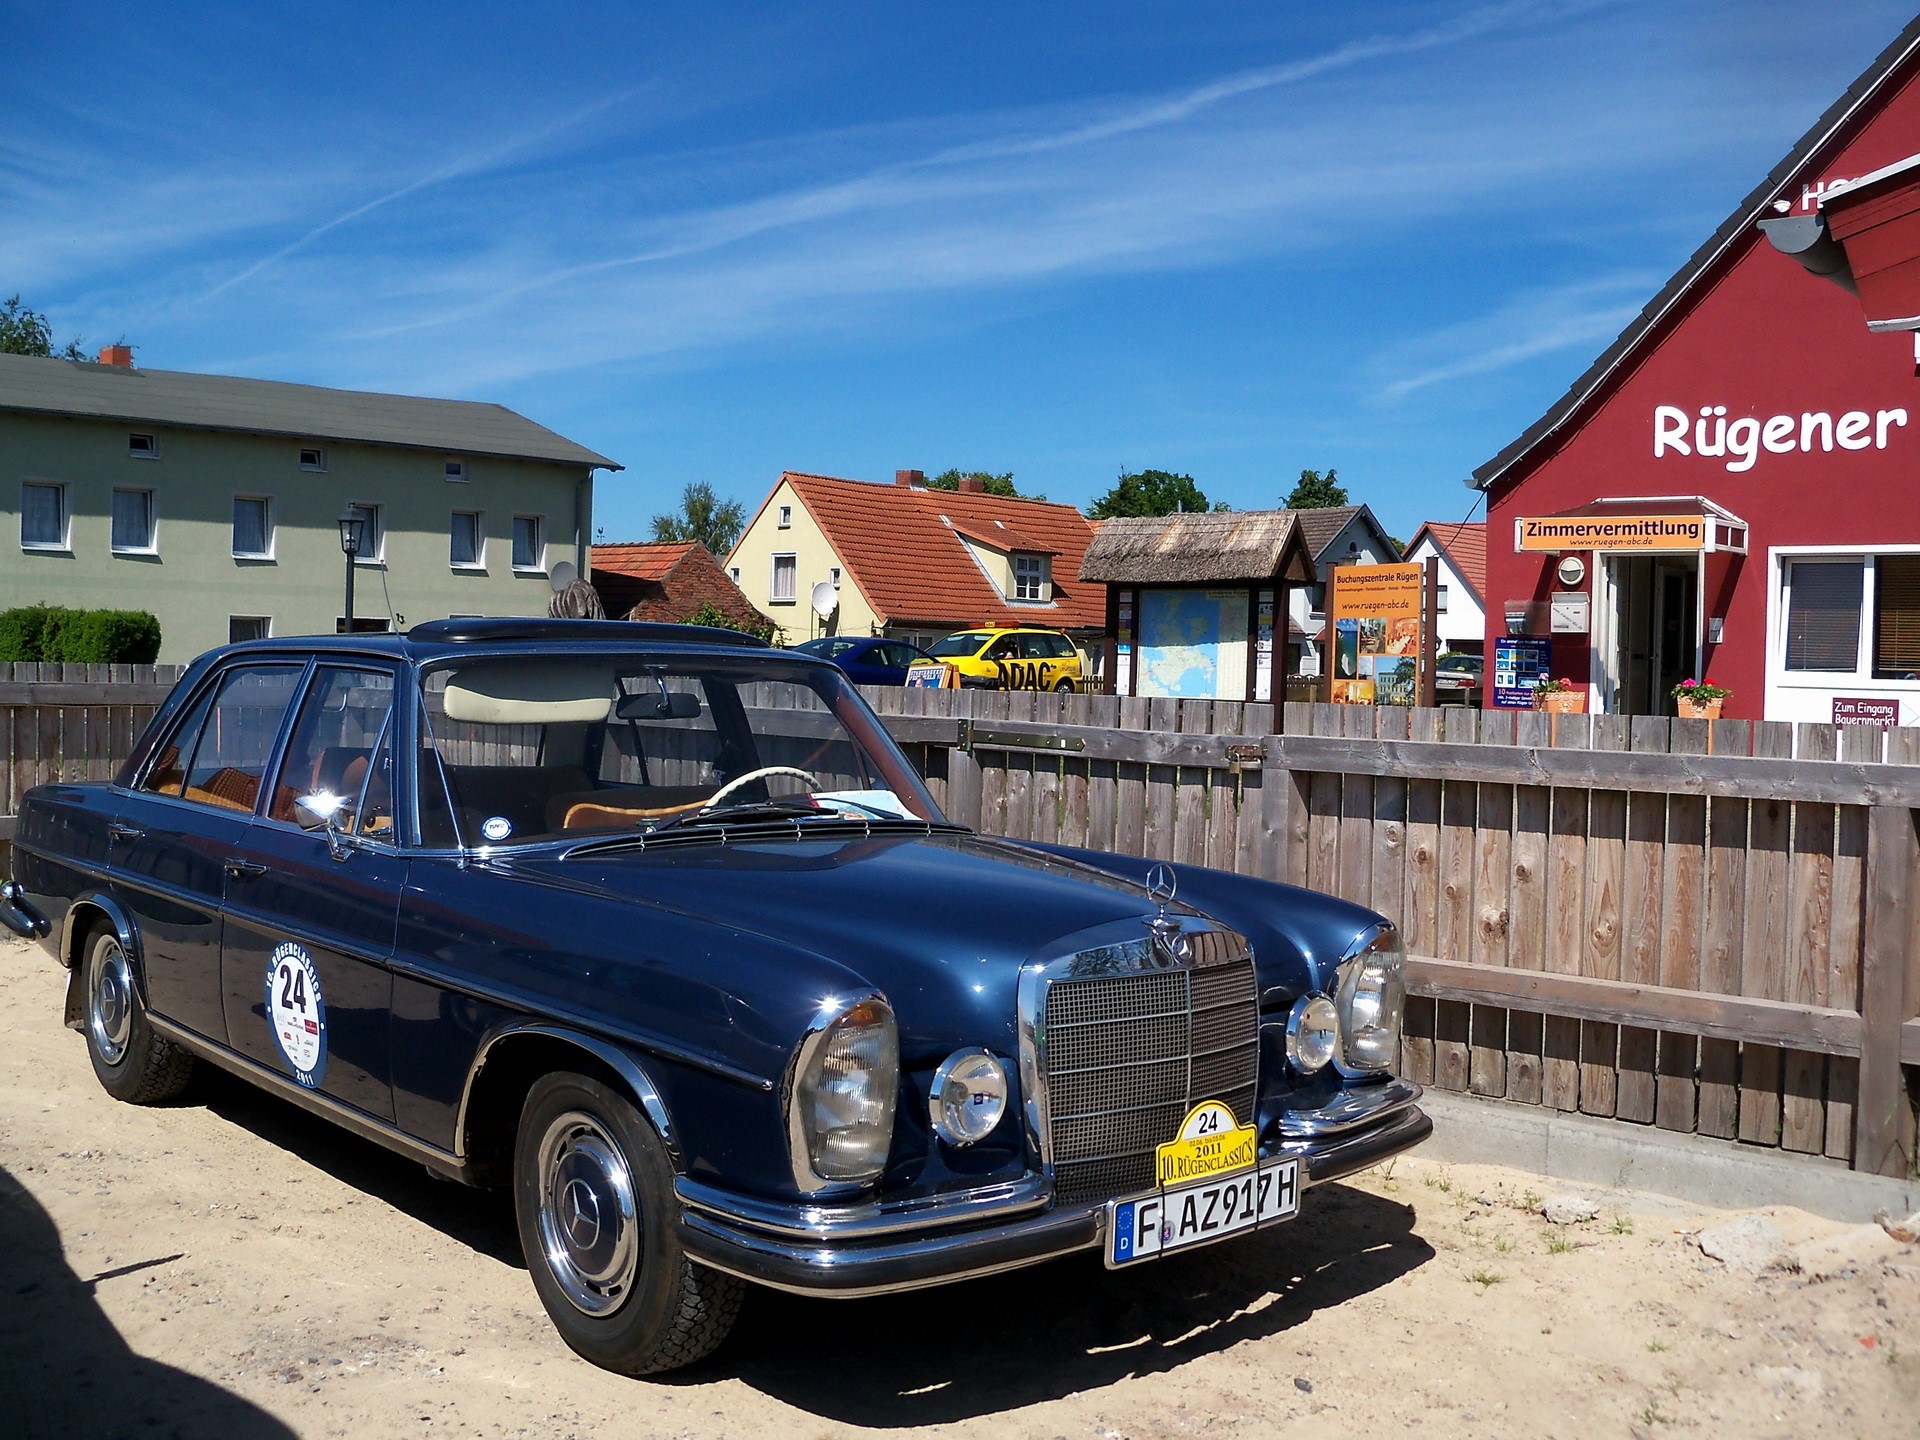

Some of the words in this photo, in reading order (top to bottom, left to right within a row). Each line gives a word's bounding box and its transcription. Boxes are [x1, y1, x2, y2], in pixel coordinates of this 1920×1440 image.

[1653, 405, 1908, 473] Rügener
[1526, 520, 1699, 539] Zimmervermittlung
[1570, 537, 1653, 548] www.ruegen-abc.de
[1337, 573, 1395, 584] Buchungszentrale
[1396, 572, 1419, 583] Rügen
[1342, 599, 1409, 613] www.ruegen-abc.de
[998, 661, 1051, 692] ADAC
[1834, 701, 1855, 713] Zum
[1857, 702, 1894, 717] Eingang
[1835, 713, 1896, 727] Bauernmarkt
[280, 964, 307, 1014] 24
[295, 1069, 315, 1086] 2011
[1198, 1110, 1218, 1134] 24
[1161, 1153, 1176, 1181] 10.
[1177, 1137, 1253, 1179] RÜGENCLASSICS
[1195, 1142, 1221, 1159] 2011
[1120, 1237, 1129, 1250] D
[1138, 1202, 1158, 1248] F
